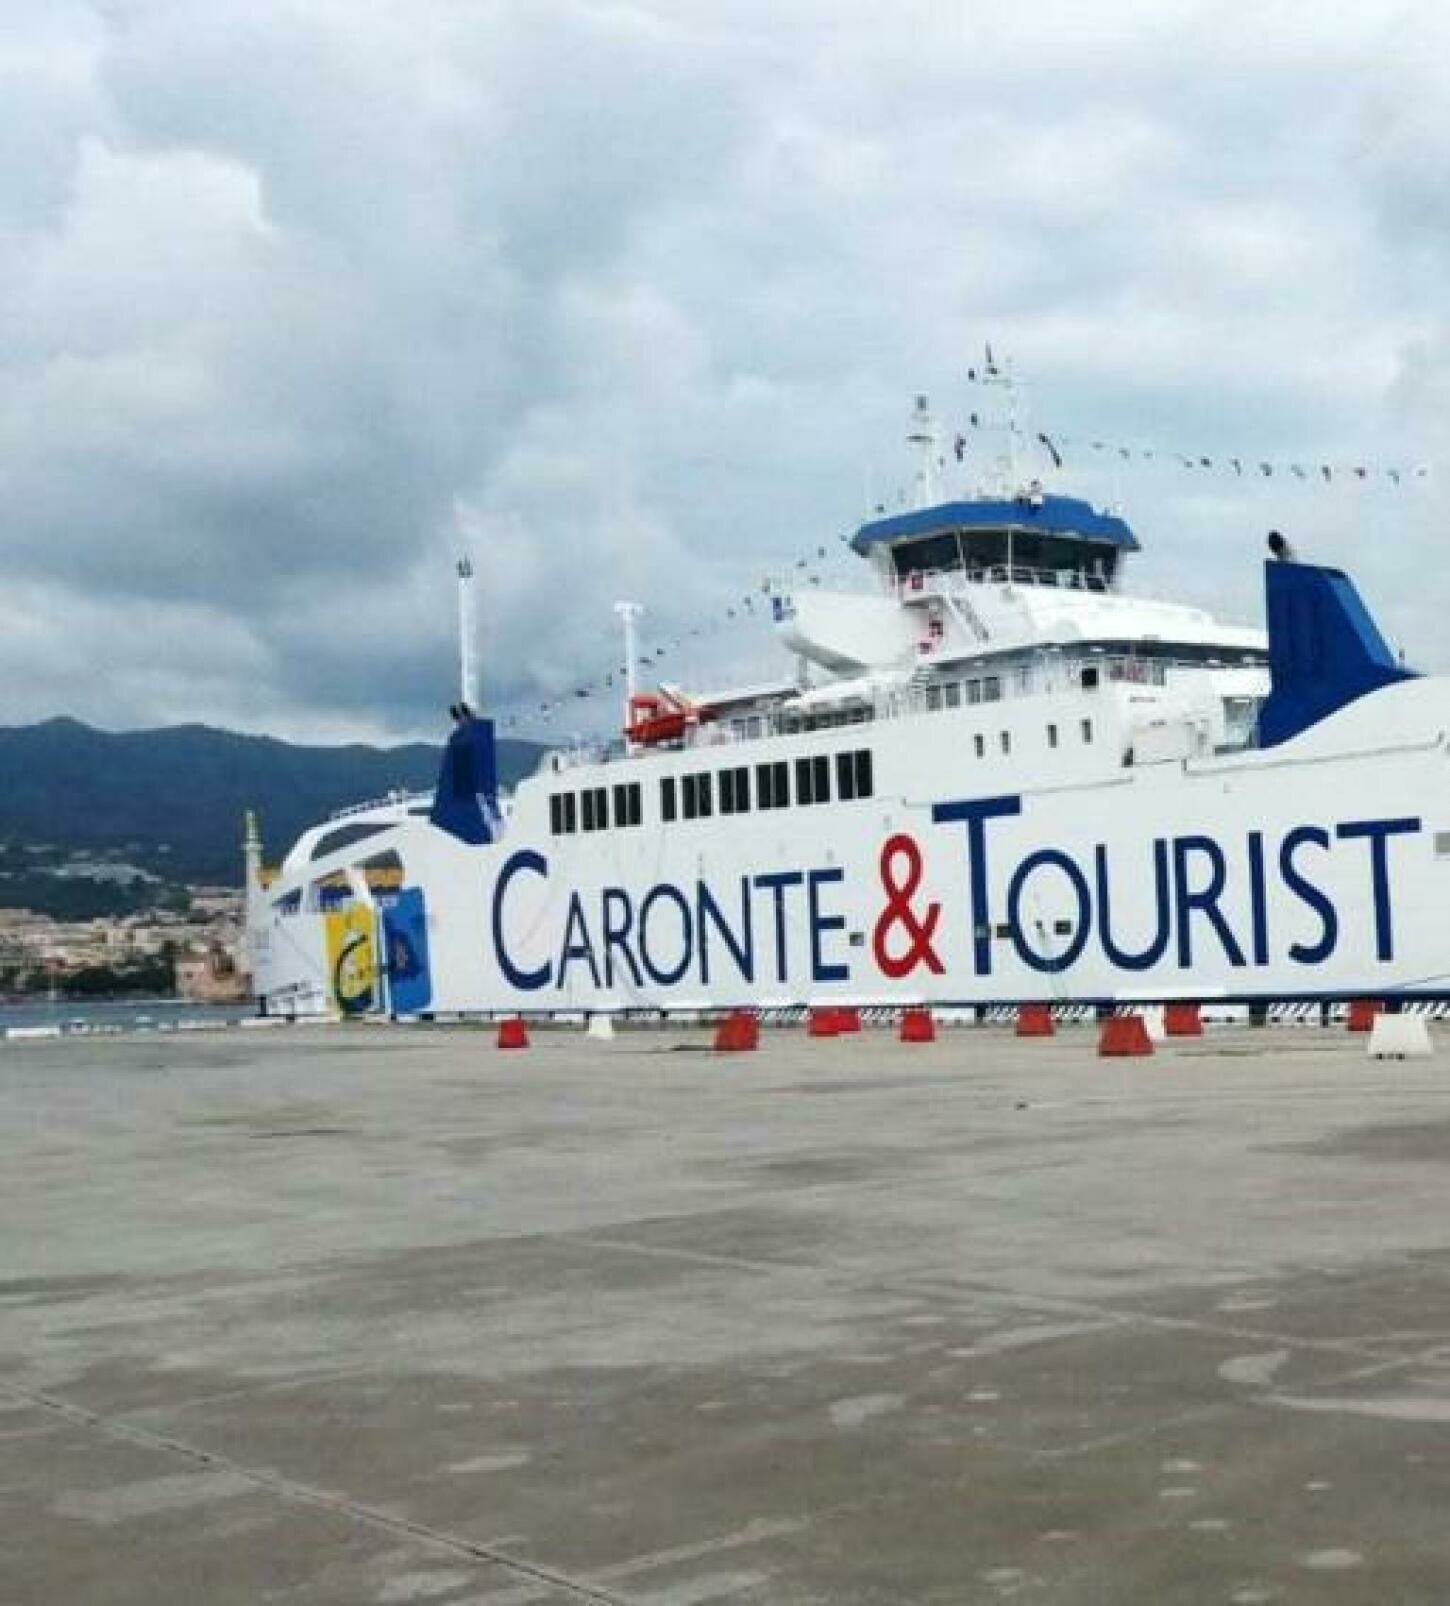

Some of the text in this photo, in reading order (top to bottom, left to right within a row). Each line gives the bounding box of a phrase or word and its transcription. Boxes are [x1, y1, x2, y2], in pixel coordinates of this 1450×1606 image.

[492, 794, 1423, 993] CARONTE & TOURIST
